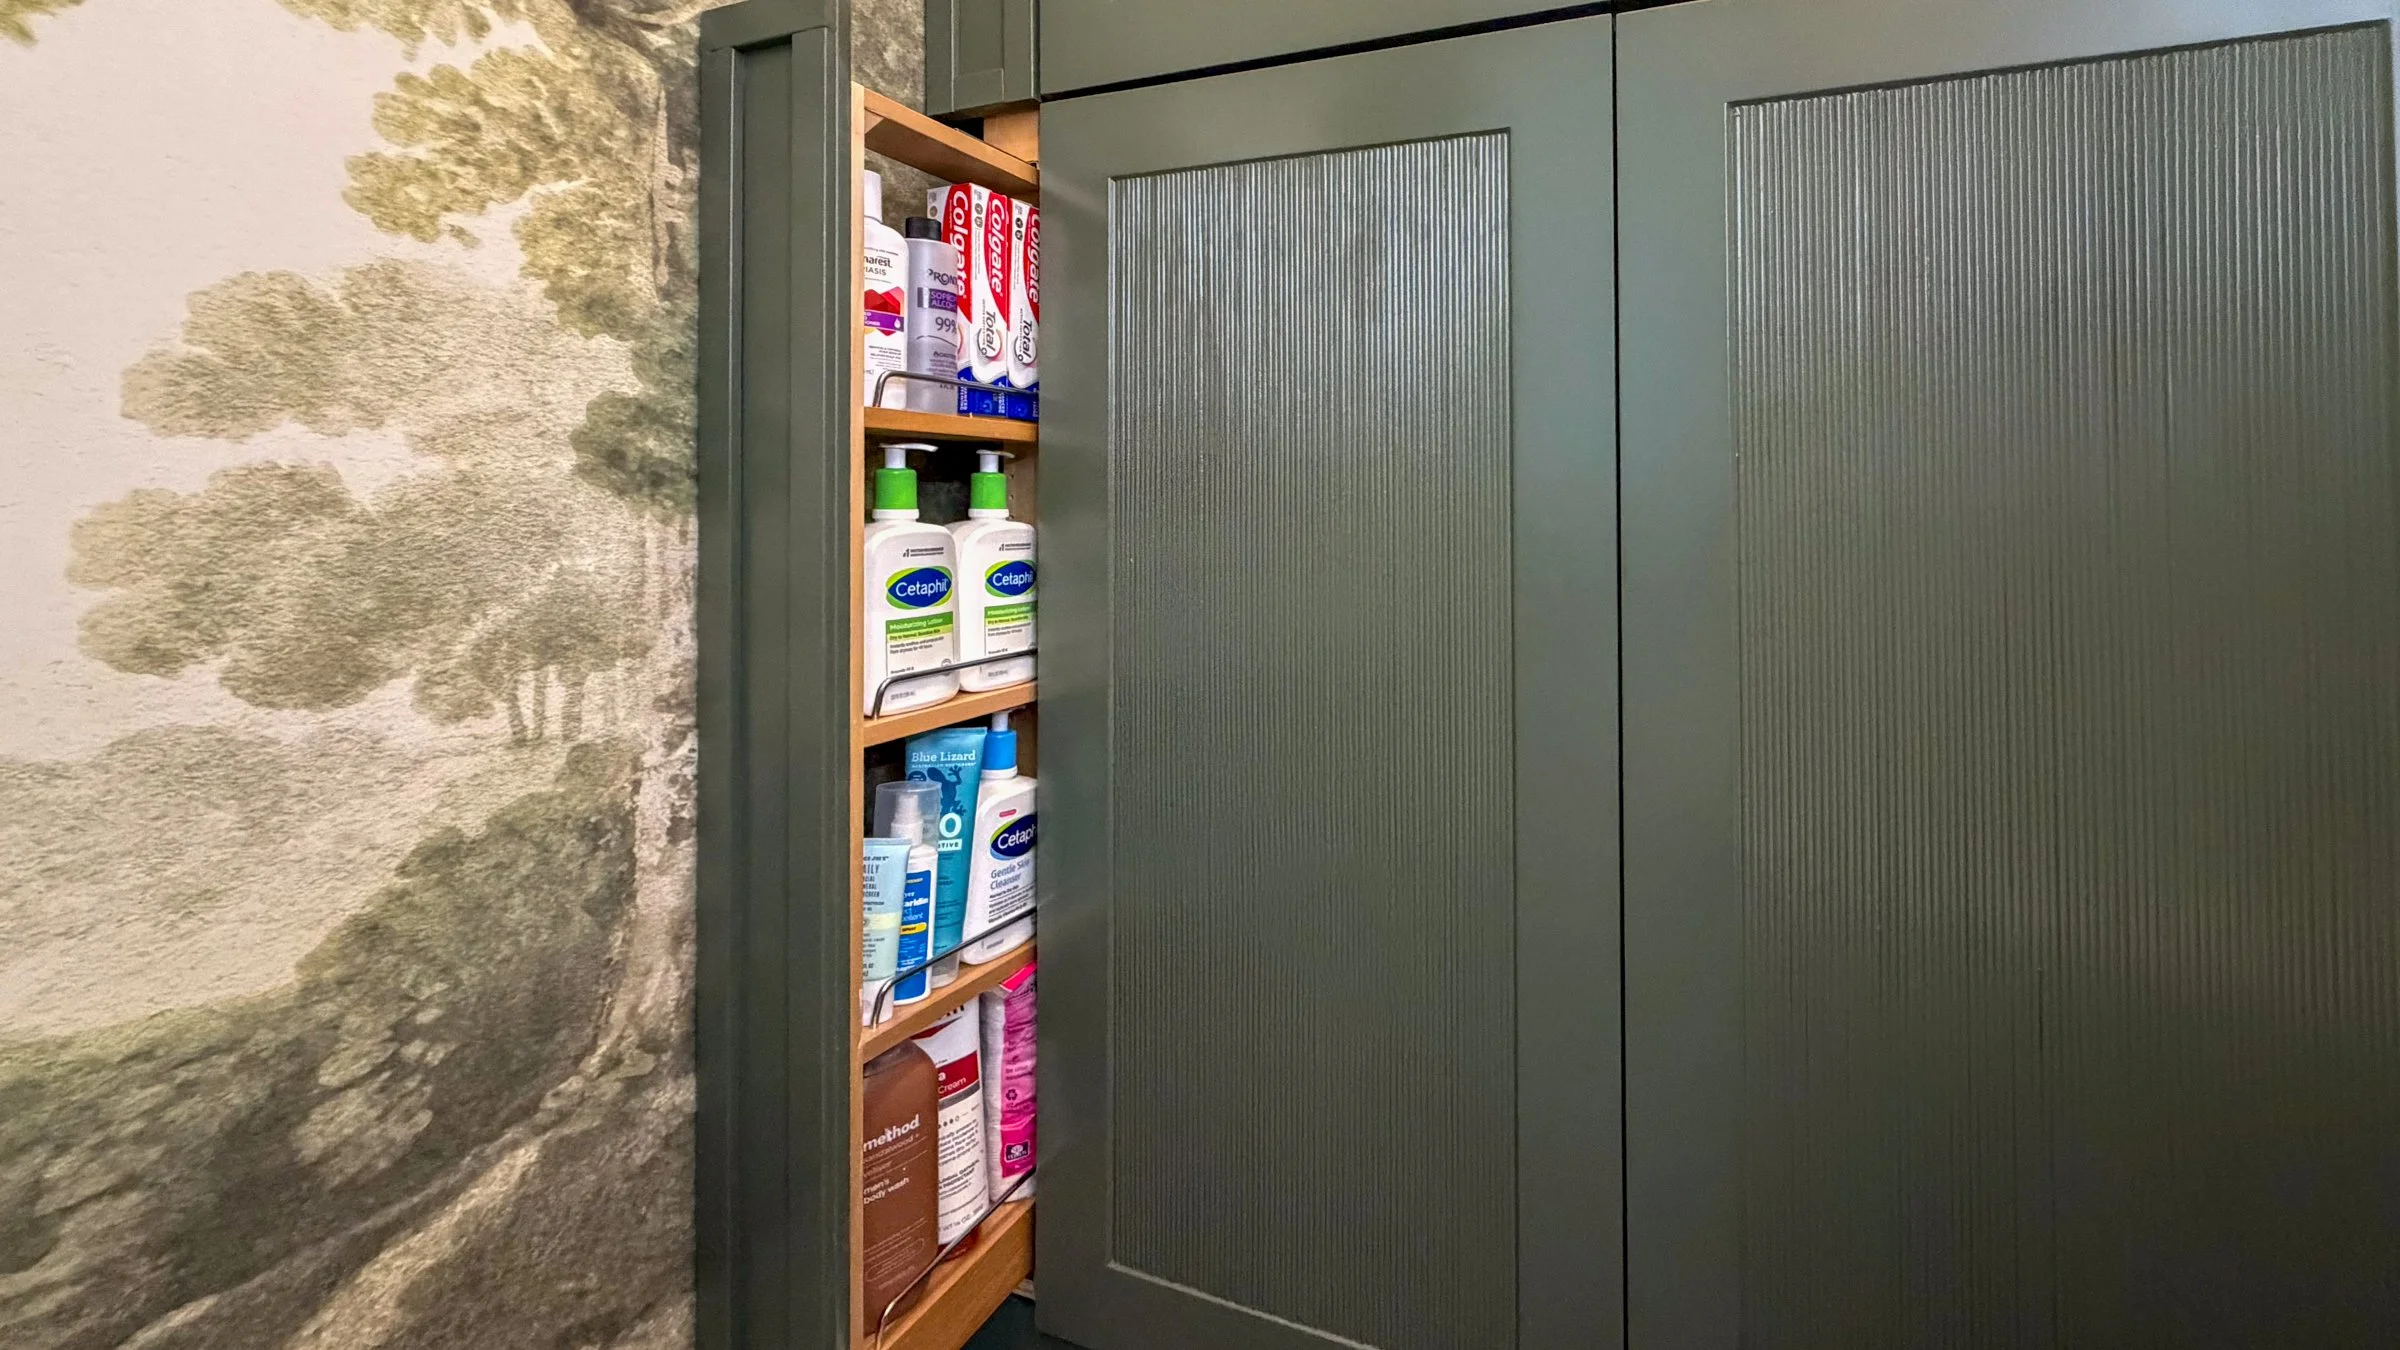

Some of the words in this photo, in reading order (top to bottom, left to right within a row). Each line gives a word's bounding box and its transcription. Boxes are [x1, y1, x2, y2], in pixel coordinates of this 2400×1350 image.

[949, 191, 969, 296] Colgate
[988, 198, 1005, 294] Colgate
[864, 267, 887, 276] IASIS
[985, 311, 996, 352] Total
[1022, 320, 1033, 358] Total
[895, 578, 948, 597] Cetaphil
[911, 752, 938, 762] Blue
[940, 749, 976, 761] Lizard
[990, 863, 1016, 879] Gentle
[938, 1077, 967, 1094] Cream
[863, 1113, 920, 1152] method
